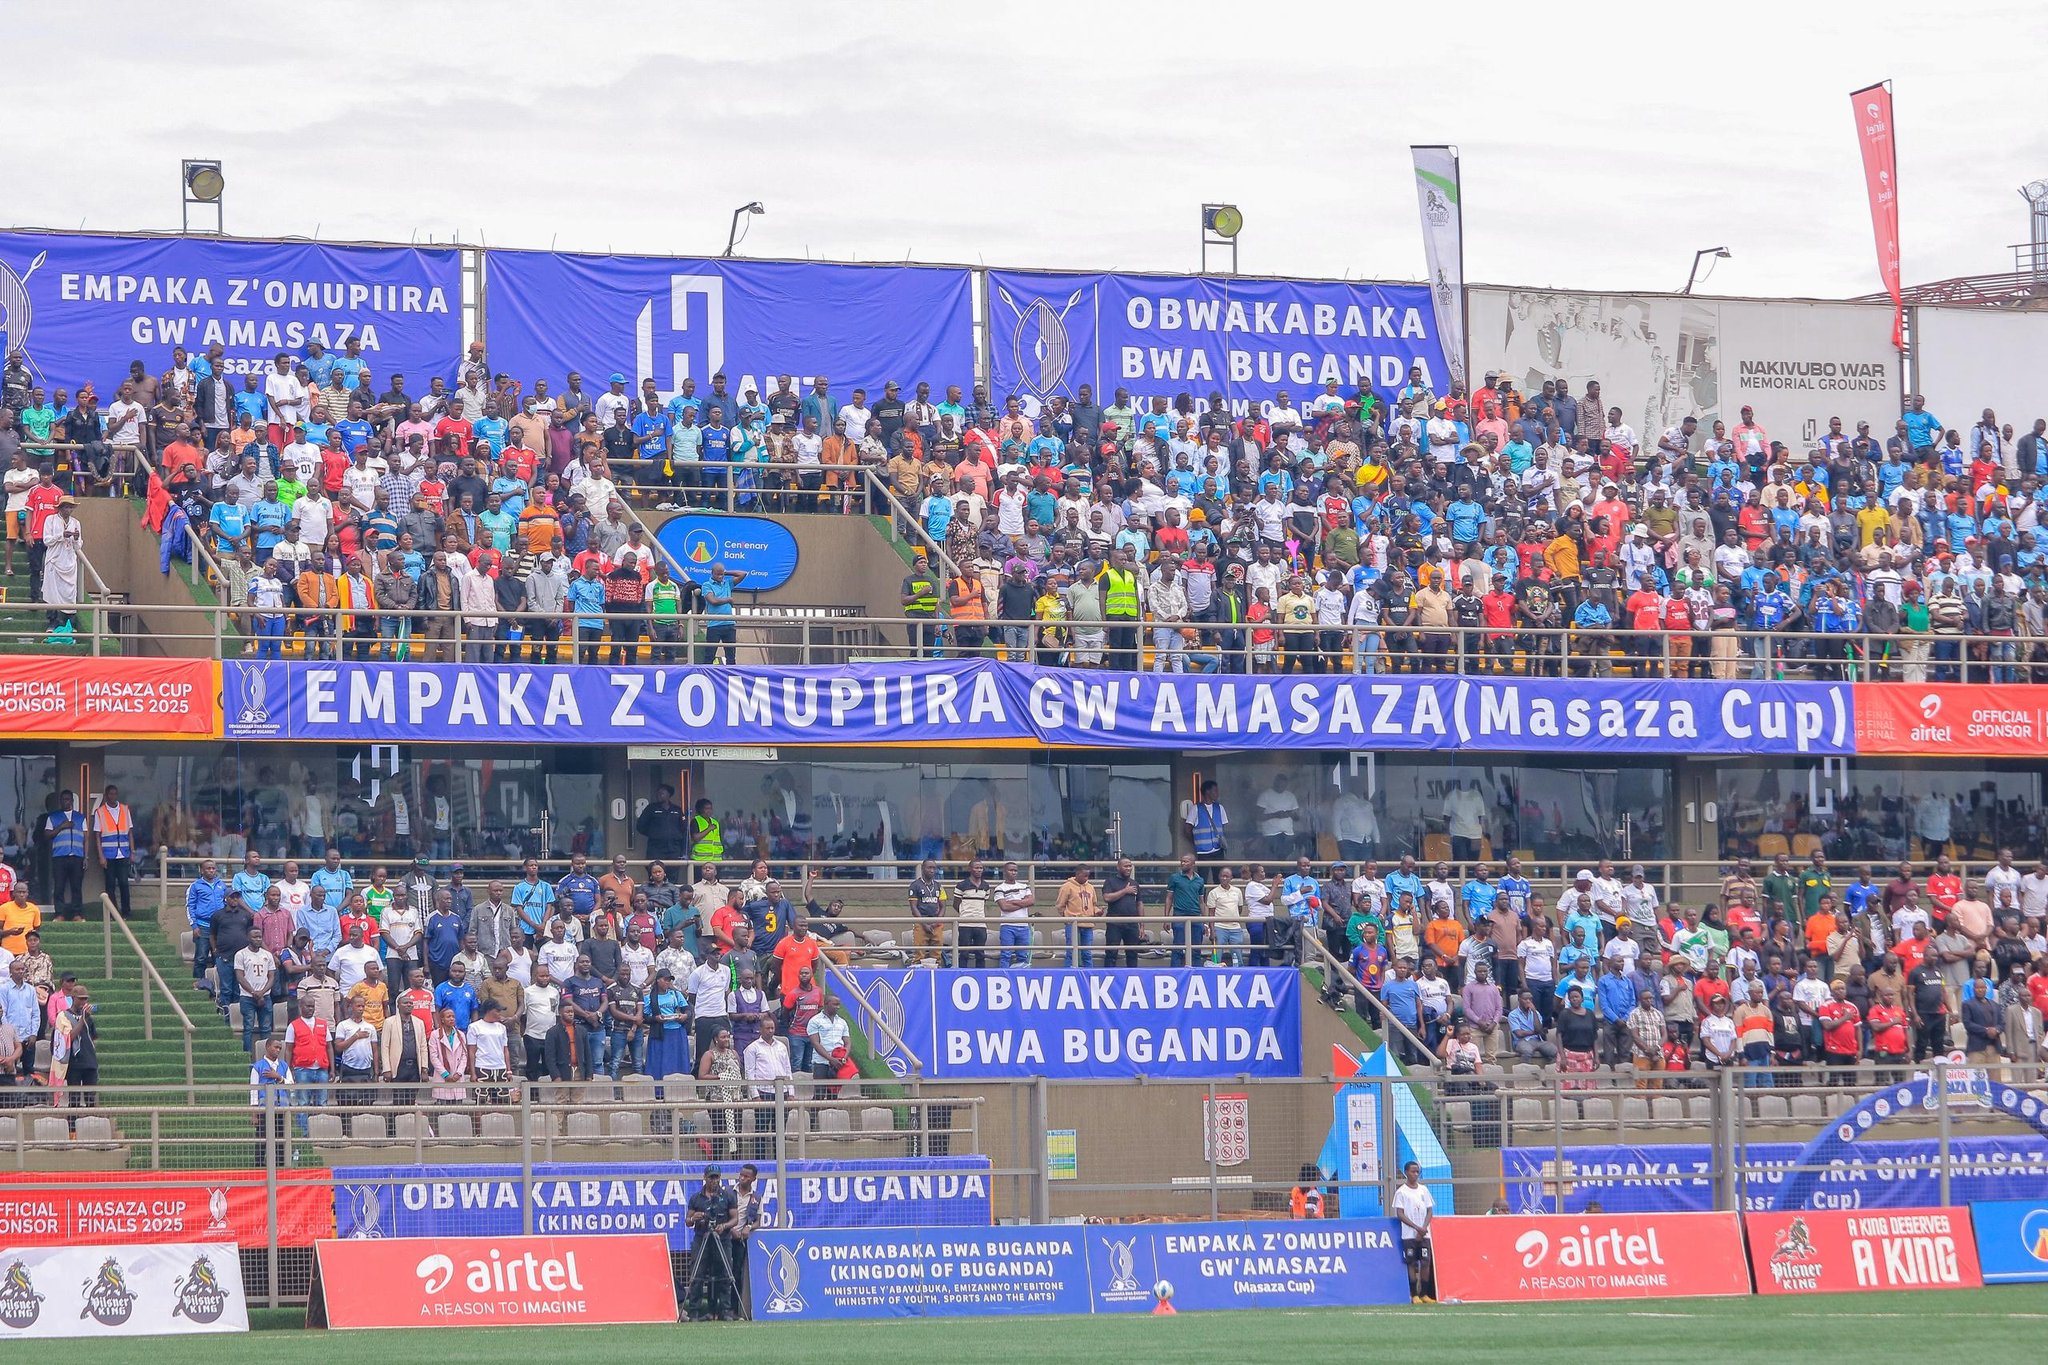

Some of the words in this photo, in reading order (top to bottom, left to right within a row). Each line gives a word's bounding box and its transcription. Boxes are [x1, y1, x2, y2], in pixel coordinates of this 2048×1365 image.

[61, 273, 214, 305] EMPAKA
[227, 279, 449, 314] Z'OMUPIIRA
[1127, 296, 1427, 341] OBWAKABAKA
[131, 316, 381, 351] GW'AMASAZA
[1121, 346, 1213, 381] BWA
[1739, 360, 1837, 377] NAKIVUBO
[1840, 362, 1885, 377] WAR
[1740, 376, 1815, 390] MEMORIAL
[1818, 378, 1886, 391] GROUNDS
[724, 540, 769, 552] Centenary
[724, 551, 746, 560] Bank
[751, 569, 769, 577] Group
[0, 682, 66, 697] FFICIAL
[85, 682, 155, 697] MASAZA
[158, 683, 193, 698] CUP
[85, 699, 145, 713] FINALS
[148, 699, 189, 714] 2025
[306, 669, 584, 726] EMPAKA
[609, 670, 1007, 729] Z'OMUPIIRA
[1721, 685, 1847, 753] Cup)
[1972, 709, 2033, 724] OFFICIAL
[1911, 723, 1952, 742] airtel
[1967, 724, 2032, 738] SPONSOR
[660, 748, 719, 758] EXECUTIVE
[765, 912, 778, 932] 3
[951, 974, 1276, 1012] OBWAKABAKA
[946, 1029, 1046, 1065] BWA
[1063, 1026, 1283, 1064] BUGANDA
[1876, 1152, 2048, 1181] GW'AMASAZ
[800, 1175, 987, 1204] BUGANDA
[1813, 1188, 1862, 1210] Cup)
[78, 1201, 147, 1217] MASAZA
[151, 1201, 187, 1217] CUP
[78, 1218, 138, 1233] FINALS
[141, 1217, 183, 1233] 2025
[538, 1213, 650, 1234] (KINGDOM
[653, 1212, 680, 1230] OF
[1847, 1218, 1858, 1237] A
[1859, 1217, 1889, 1237] KING
[1890, 1215, 1951, 1236] DESERVES
[808, 1243, 936, 1261] OBWAKABAKA
[942, 1242, 981, 1258] BWA
[986, 1241, 1073, 1257] BUGANDA
[1165, 1235, 1257, 1254] EMPAKA
[1262, 1231, 1393, 1252] Z'OMUPIIRA
[1558, 1225, 1665, 1267] airtel
[1200, 1256, 1348, 1278] GW'AMASAZA
[1851, 1239, 1880, 1287] A
[1881, 1235, 1962, 1286] KING
[466, 1248, 584, 1293] airtel
[830, 1263, 925, 1282] (KINGDOM
[930, 1263, 954, 1278] OF
[960, 1260, 1054, 1278] BUGANDA)
[1770, 1261, 1823, 1284] Pilsner
[824, 1286, 877, 1296] MINISTULE
[954, 1282, 1011, 1292] EMIZANNYO
[1013, 1281, 1064, 1291] N'EBITONE
[1233, 1280, 1286, 1295] (Masaza
[1287, 1279, 1315, 1294] Cup)
[1519, 1277, 1529, 1290] A
[1531, 1276, 1586, 1290] REASON
[1587, 1275, 1608, 1288] TO
[1609, 1273, 1668, 1287] IMAGINE
[1782, 1279, 1817, 1290] KING
[90, 1296, 129, 1312] Pilsner
[182, 1295, 221, 1310] Pilsner
[833, 1295, 885, 1307] (MINISTRY
[888, 1296, 901, 1305] OF
[903, 1295, 941, 1305] YOUTH,
[943, 1294, 981, 1303] SPORTS
[983, 1293, 1003, 1303] AND
[1005, 1292, 1025, 1302] THE
[1027, 1291, 1056, 1302] ARTS)
[5, 1309, 34, 1319] KING
[98, 1306, 126, 1317] KING
[190, 1304, 218, 1315] KING
[420, 1303, 431, 1316] A
[434, 1302, 495, 1316] REASON
[497, 1301, 519, 1315] TO
[522, 1300, 587, 1314] IMAGINE
